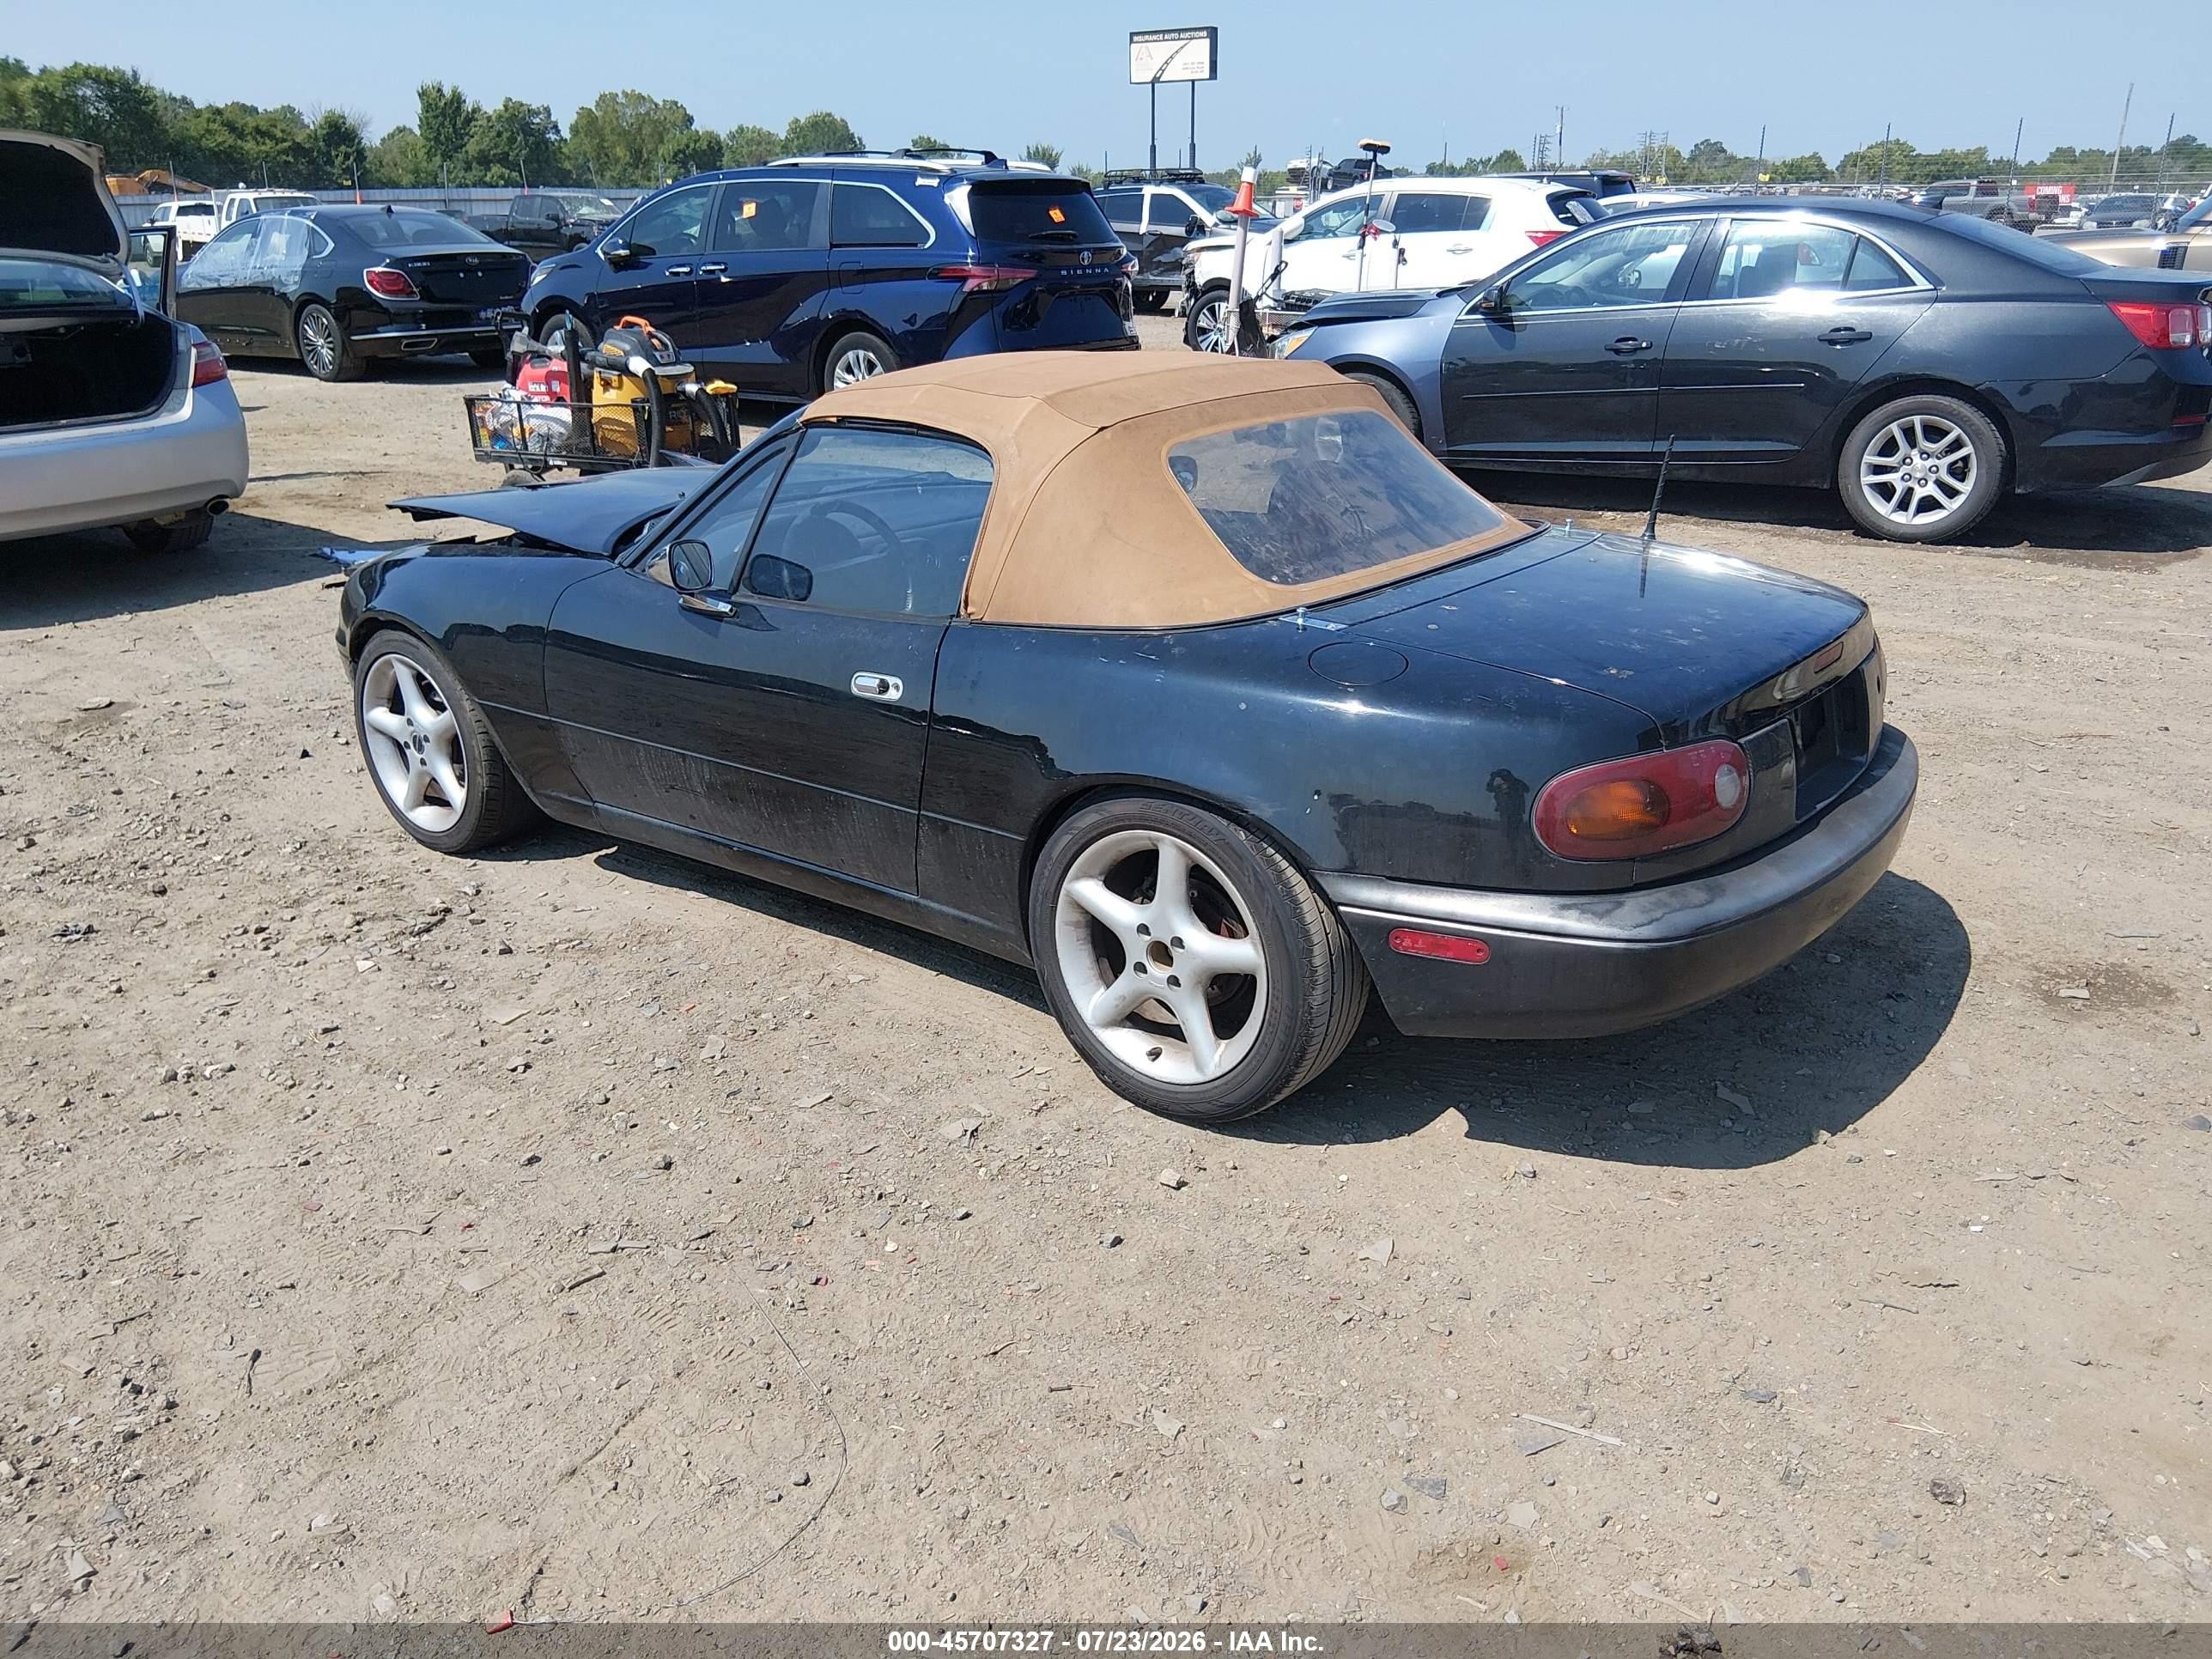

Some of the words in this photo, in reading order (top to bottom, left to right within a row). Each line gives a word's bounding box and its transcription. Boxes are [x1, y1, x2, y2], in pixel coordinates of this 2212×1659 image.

[1133, 33, 1164, 42] INSURANCE
[1180, 30, 1207, 39] AUCTIONS
[2036, 185, 2062, 195] COMING
[1060, 267, 1109, 276] SIENNA
